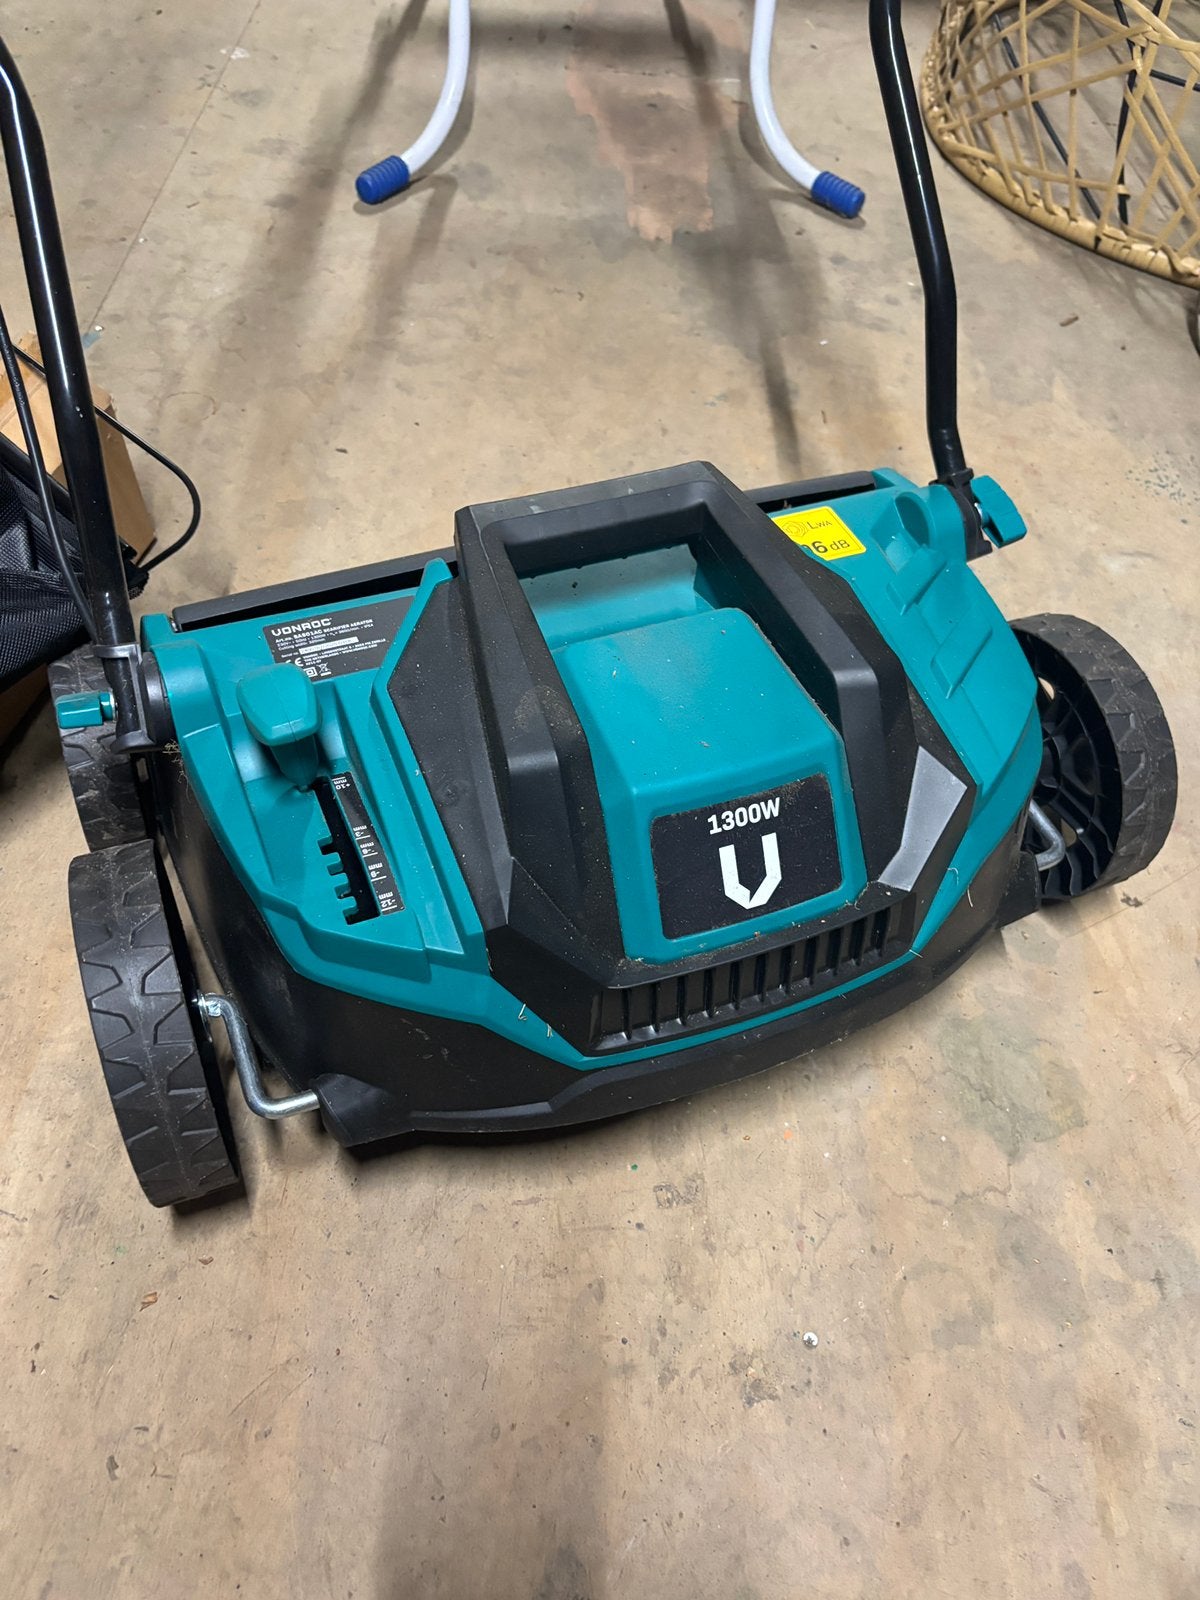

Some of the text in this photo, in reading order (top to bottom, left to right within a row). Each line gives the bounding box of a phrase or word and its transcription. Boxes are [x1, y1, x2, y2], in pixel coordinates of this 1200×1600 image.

[271, 618, 332, 636] VONROC
[707, 797, 781, 835] 1300W
[380, 898, 396, 908] -12
